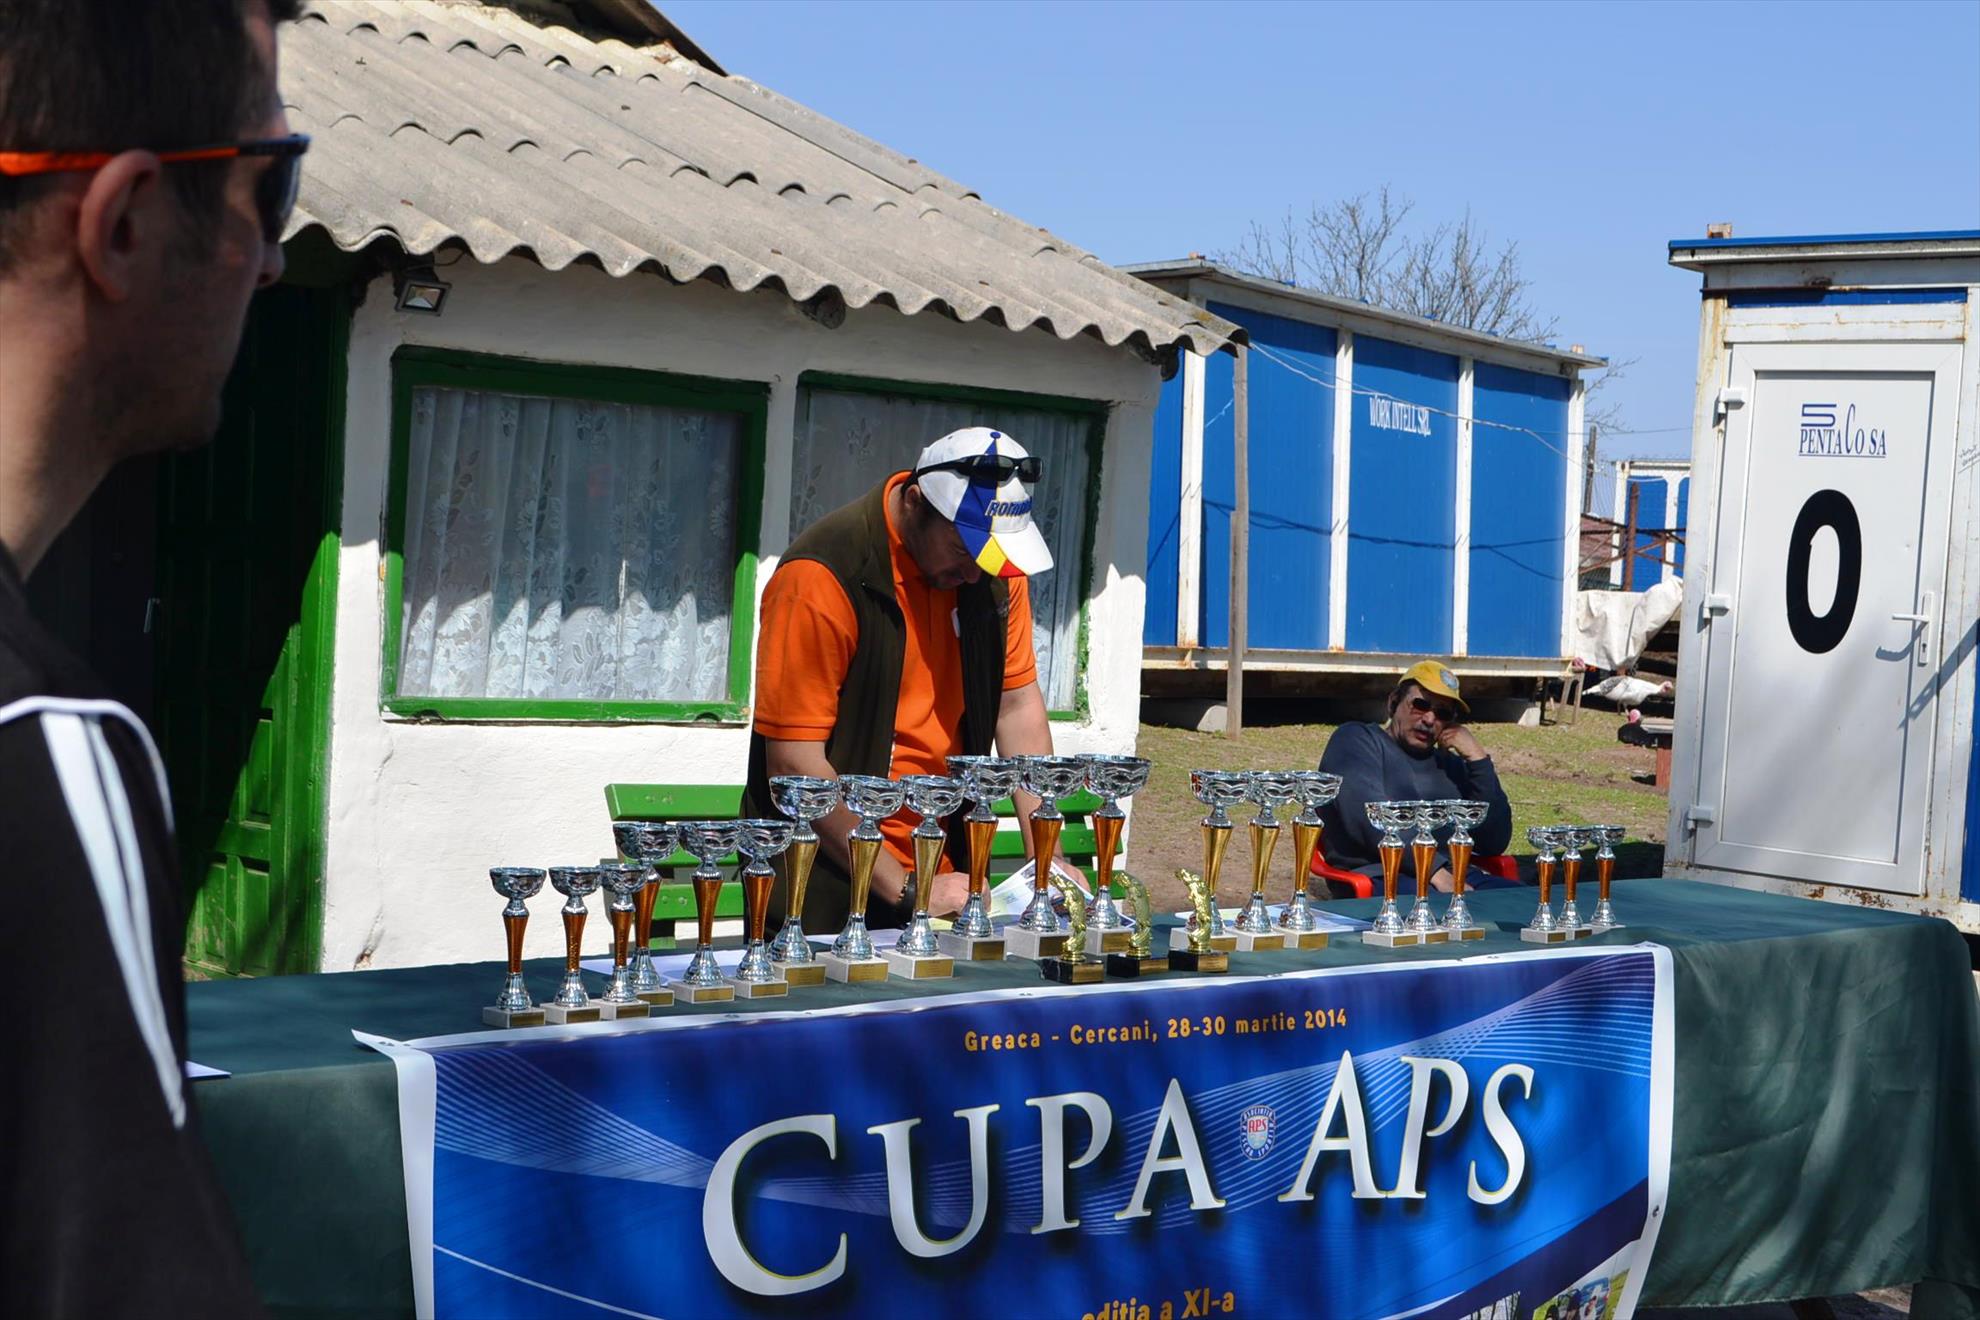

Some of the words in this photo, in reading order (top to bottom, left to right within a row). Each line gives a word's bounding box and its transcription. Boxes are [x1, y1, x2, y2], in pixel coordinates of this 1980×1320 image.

[1369, 394, 1391, 430] WORK
[1392, 400, 1417, 433] INTELL
[1868, 428, 1887, 456] SA
[965, 1031, 1040, 1051] Greaca
[1070, 1023, 1159, 1045] Cercani,
[1168, 1015, 1226, 1038] 28-30
[1235, 1010, 1296, 1034] martie
[1305, 1008, 1347, 1029] 2014
[1248, 1118, 1268, 1133] APS
[702, 1077, 1227, 1297] CUPA
[1278, 1050, 1535, 1207] APS
[1160, 1301, 1173, 1320] a
[1181, 1287, 1235, 1320] XI-a
